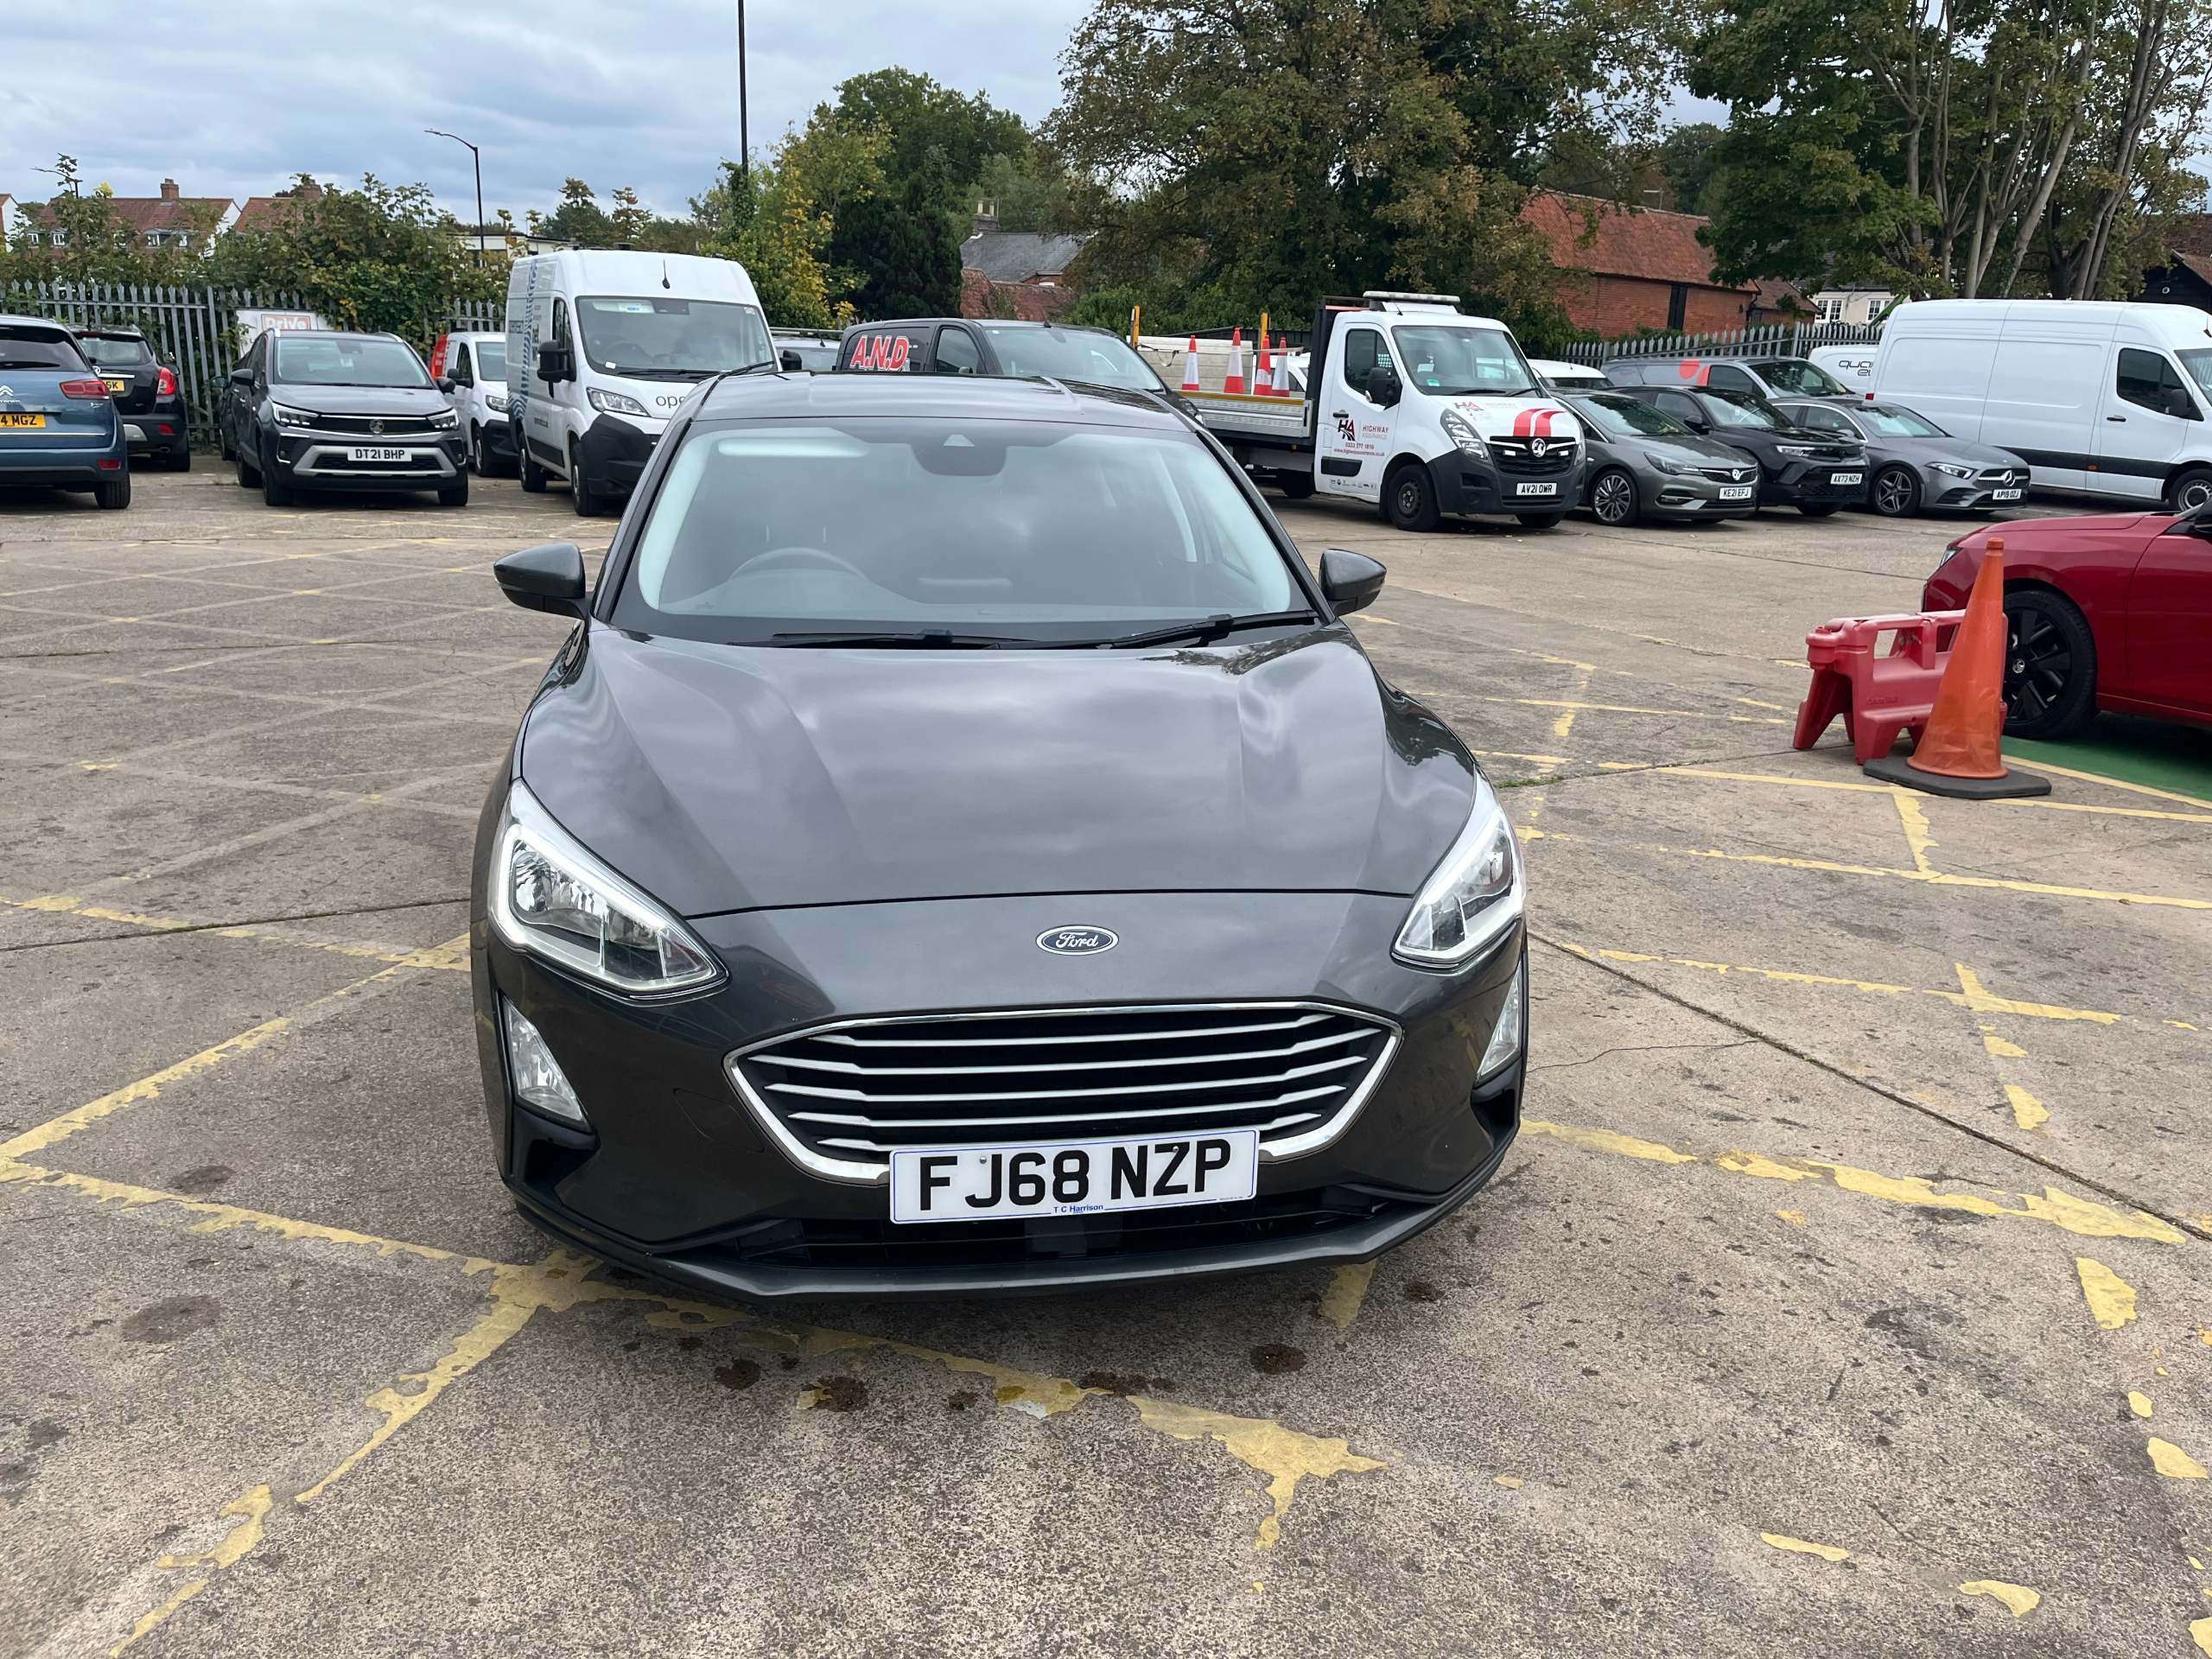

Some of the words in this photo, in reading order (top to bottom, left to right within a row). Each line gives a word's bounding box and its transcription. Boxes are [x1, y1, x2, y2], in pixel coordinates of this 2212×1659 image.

[12, 415, 37, 425] MGZ
[1362, 424, 1389, 433] HIGHWAY
[355, 448, 380, 459] DT21
[384, 449, 405, 460] BHP
[1521, 485, 1537, 493] AV21
[1539, 485, 1553, 493] OWR
[1055, 931, 1099, 949] Ford
[919, 1149, 1090, 1211] FJ68
[1110, 1138, 1231, 1200] NZP
[1069, 1204, 1103, 1213] Harrison
